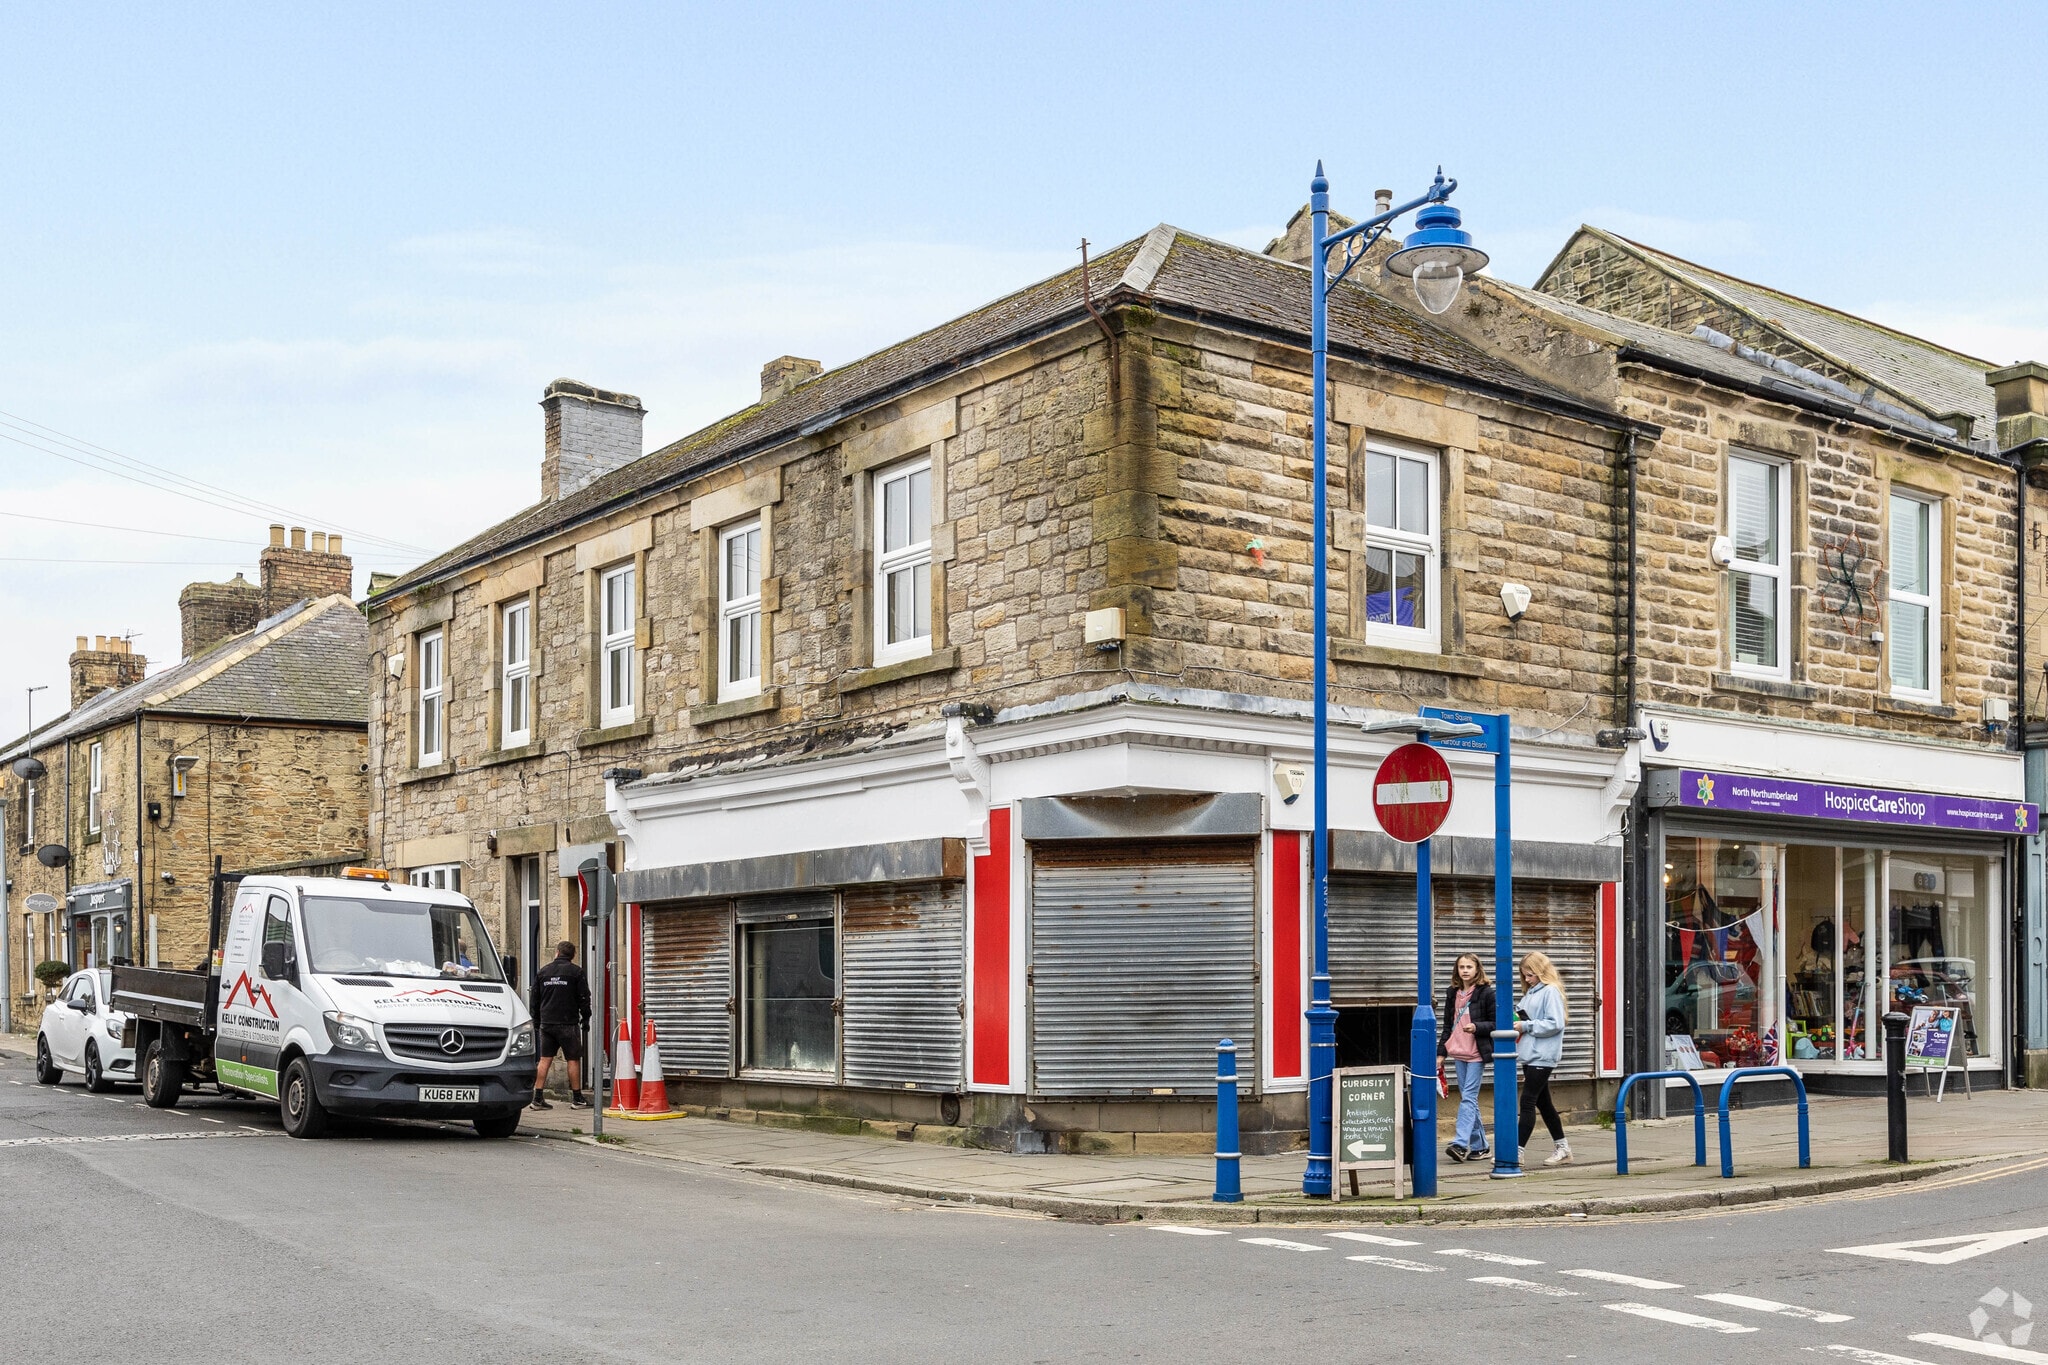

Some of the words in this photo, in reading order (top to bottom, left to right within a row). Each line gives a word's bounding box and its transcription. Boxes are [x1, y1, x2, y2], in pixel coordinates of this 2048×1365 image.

[1441, 712, 1454, 720] Town
[1455, 713, 1472, 722] Square
[1732, 787, 1750, 797] North
[1751, 789, 1798, 801] Northumberland
[416, 998, 502, 1010] CONSTRUCTION
[452, 1004, 505, 1015] STONEMASONS
[222, 1012, 237, 1025] KELLY
[238, 1015, 280, 1032] CONSTRUCTION
[222, 1027, 234, 1036] MASTER
[235, 1028, 248, 1038] BUILDER
[252, 1032, 280, 1044] STONEMASONS
[245, 1070, 268, 1085] Specialists
[1342, 1079, 1391, 1088] CURIOSITY
[424, 1089, 453, 1100] KU68
[456, 1090, 475, 1100] EKN
[1349, 1092, 1385, 1101] CORNER
